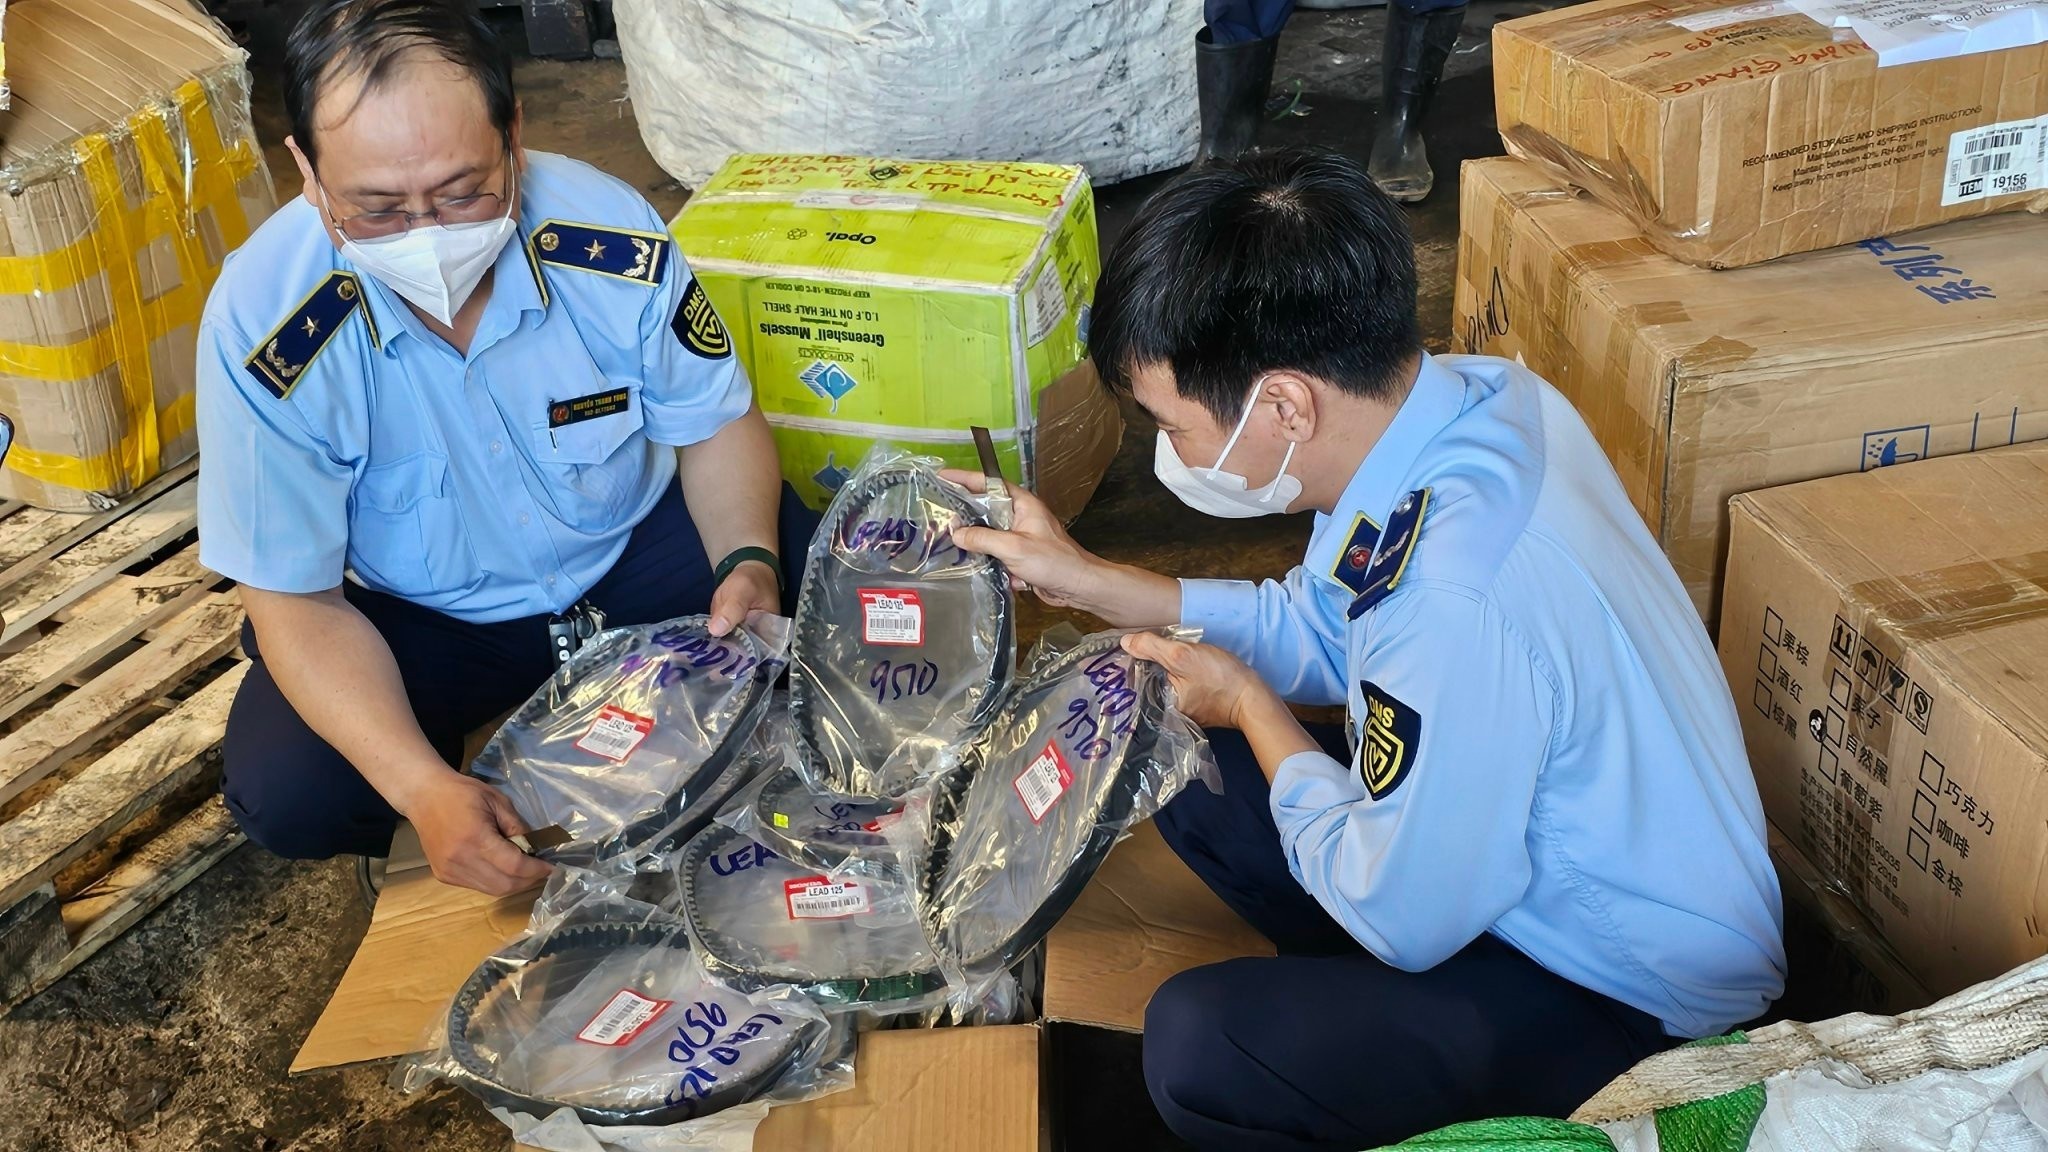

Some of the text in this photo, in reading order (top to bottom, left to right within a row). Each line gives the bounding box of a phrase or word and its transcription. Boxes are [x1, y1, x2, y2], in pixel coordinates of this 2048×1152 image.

[1743, 145, 1810, 168] RECOMMENDED
[1856, 130, 1874, 142] AND
[1876, 121, 1918, 136] SHIPPING
[1920, 105, 1983, 127] INSTRUCTIONS
[1842, 142, 1875, 154] between
[1827, 156, 1860, 169] between
[1772, 182, 1793, 193] Keep
[1960, 173, 2028, 196] ITEM 19156
[765, 282, 793, 292] COOLER
[795, 284, 805, 292] OR
[824, 287, 852, 297] FROZEN
[853, 290, 871, 299] KEEP
[683, 286, 705, 321] DMS
[762, 301, 792, 314] SHELL
[795, 304, 817, 316] HALF
[820, 306, 838, 318] THE
[840, 309, 853, 320] ON
[760, 322, 811, 341] Mussels
[877, 599, 904, 611] LEAD 125
[1776, 665, 1804, 705] 酒红
[1368, 694, 1396, 728] DMS
[1845, 733, 1889, 788] 自然黑
[1943, 777, 1995, 836] 巧克力
[1936, 818, 1970, 860] 咖啡
[1931, 858, 1964, 899] 金棕
[809, 885, 844, 897] LEAD 125
[707, 1012, 784, 1066] LEAD
